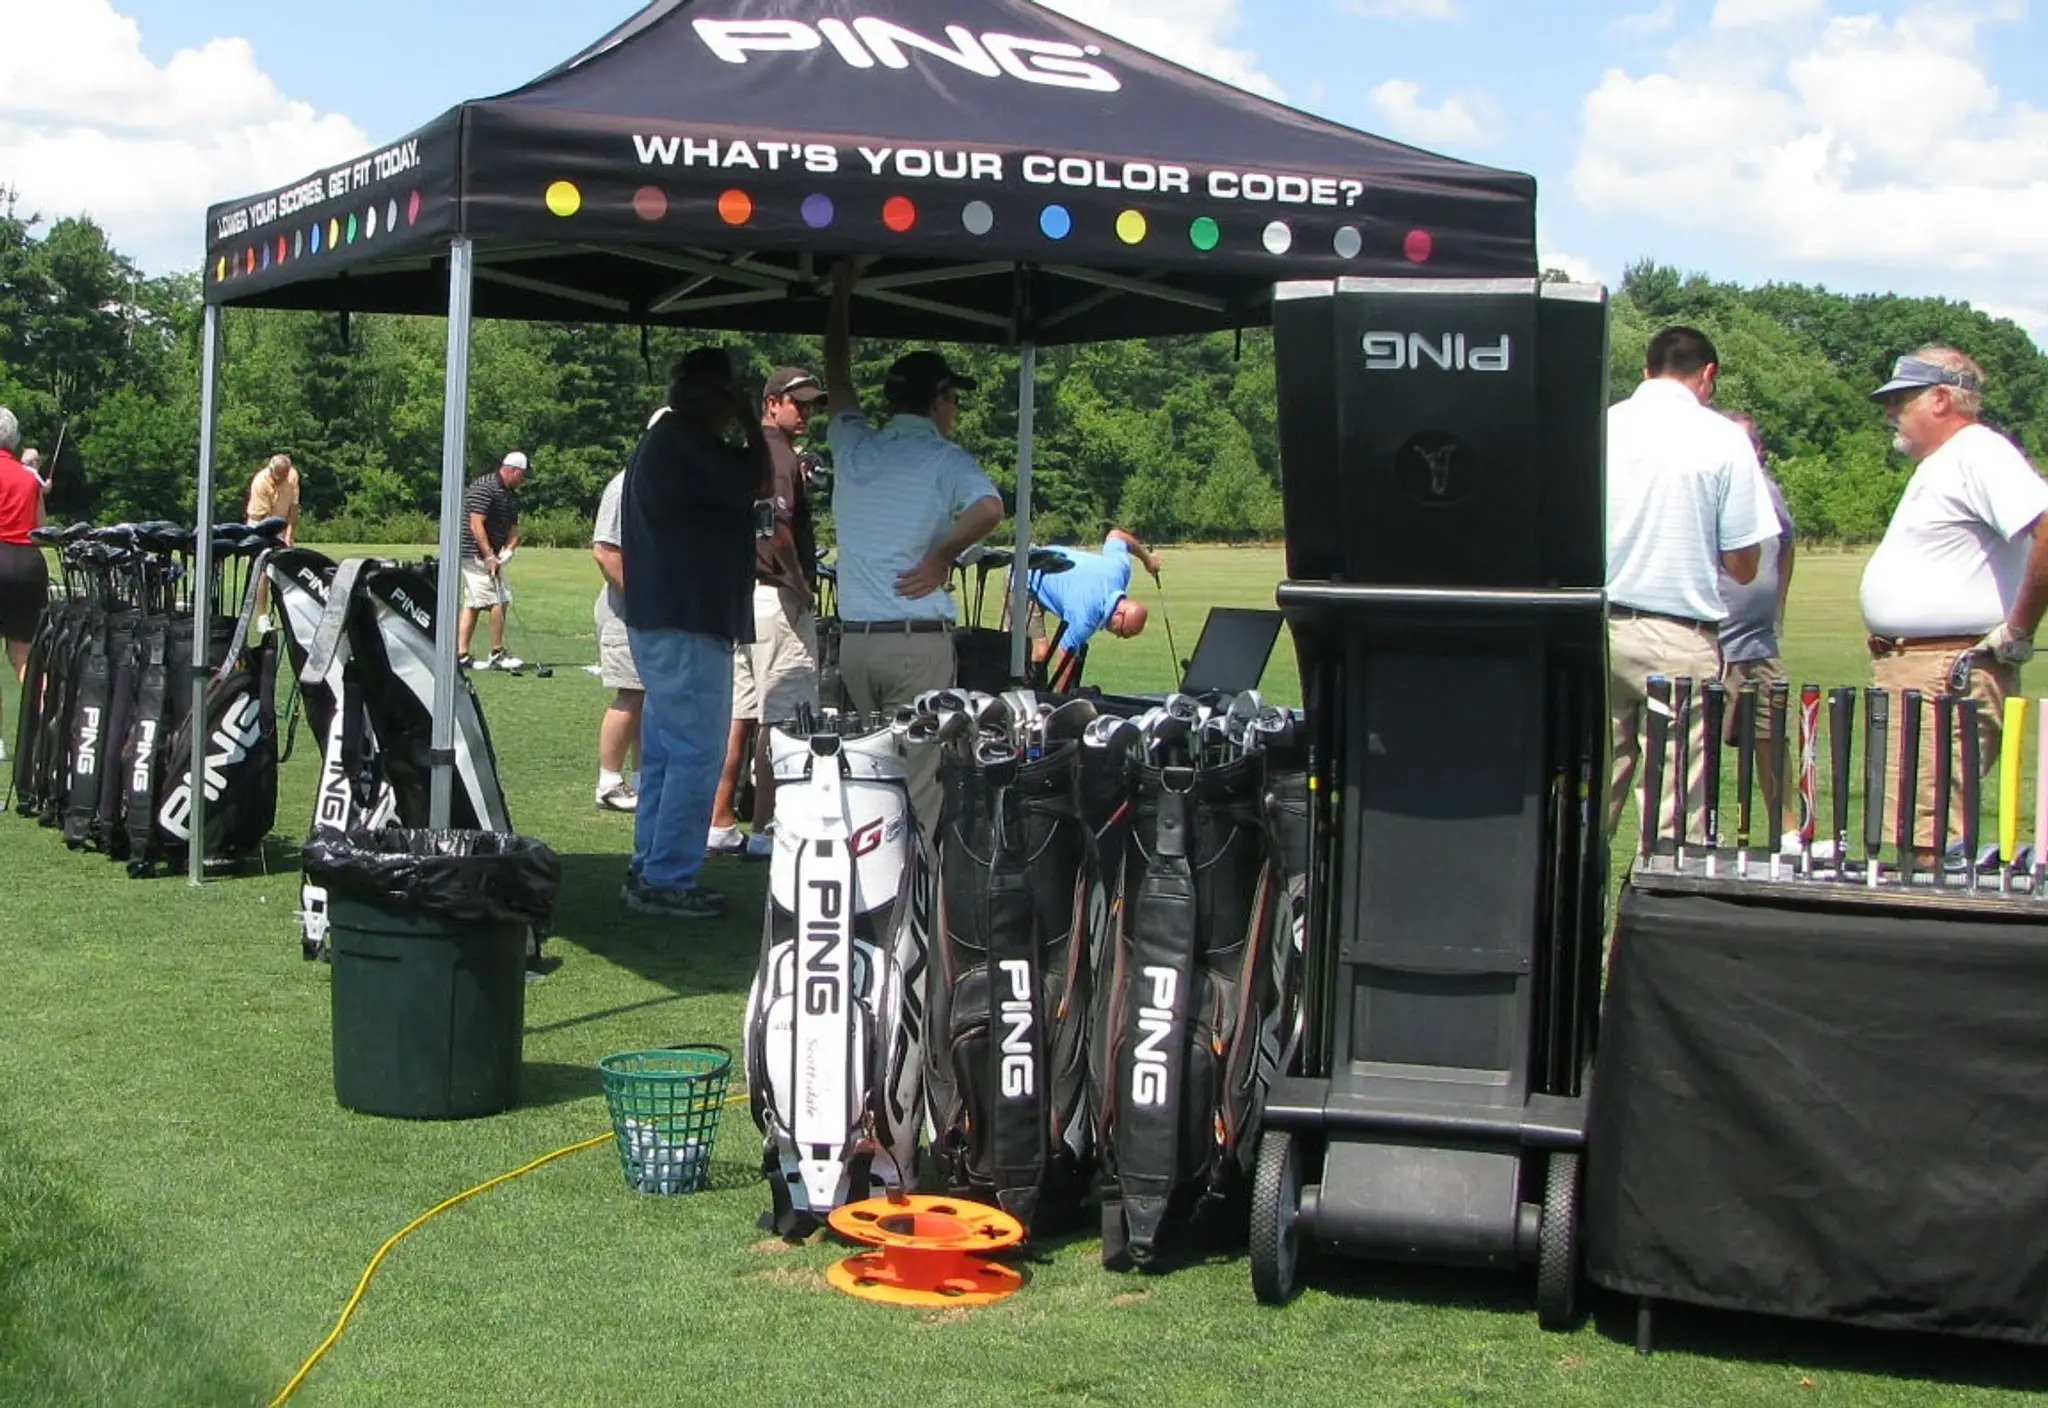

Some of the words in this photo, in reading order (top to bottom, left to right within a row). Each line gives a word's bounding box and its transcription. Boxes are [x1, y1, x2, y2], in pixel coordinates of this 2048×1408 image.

[692, 16, 1121, 92] PING
[217, 208, 248, 240] LOWER
[248, 196, 277, 228] YOUR
[328, 167, 351, 198] GET
[353, 158, 372, 189] FIT
[374, 138, 421, 181] TODAY.
[632, 134, 839, 173] WHAT'S
[858, 147, 1002, 181] YOUR
[1022, 155, 1190, 194] COLOR
[1207, 170, 1364, 207] CODE?
[1362, 330, 1509, 371] PING
[297, 567, 331, 601] PIN
[390, 587, 432, 629] PING
[76, 706, 100, 775] PING
[132, 720, 156, 792] PING
[321, 734, 348, 823] ING
[805, 879, 842, 1016] PING
[999, 959, 1033, 1097] PING
[1132, 966, 1178, 1107] PING
